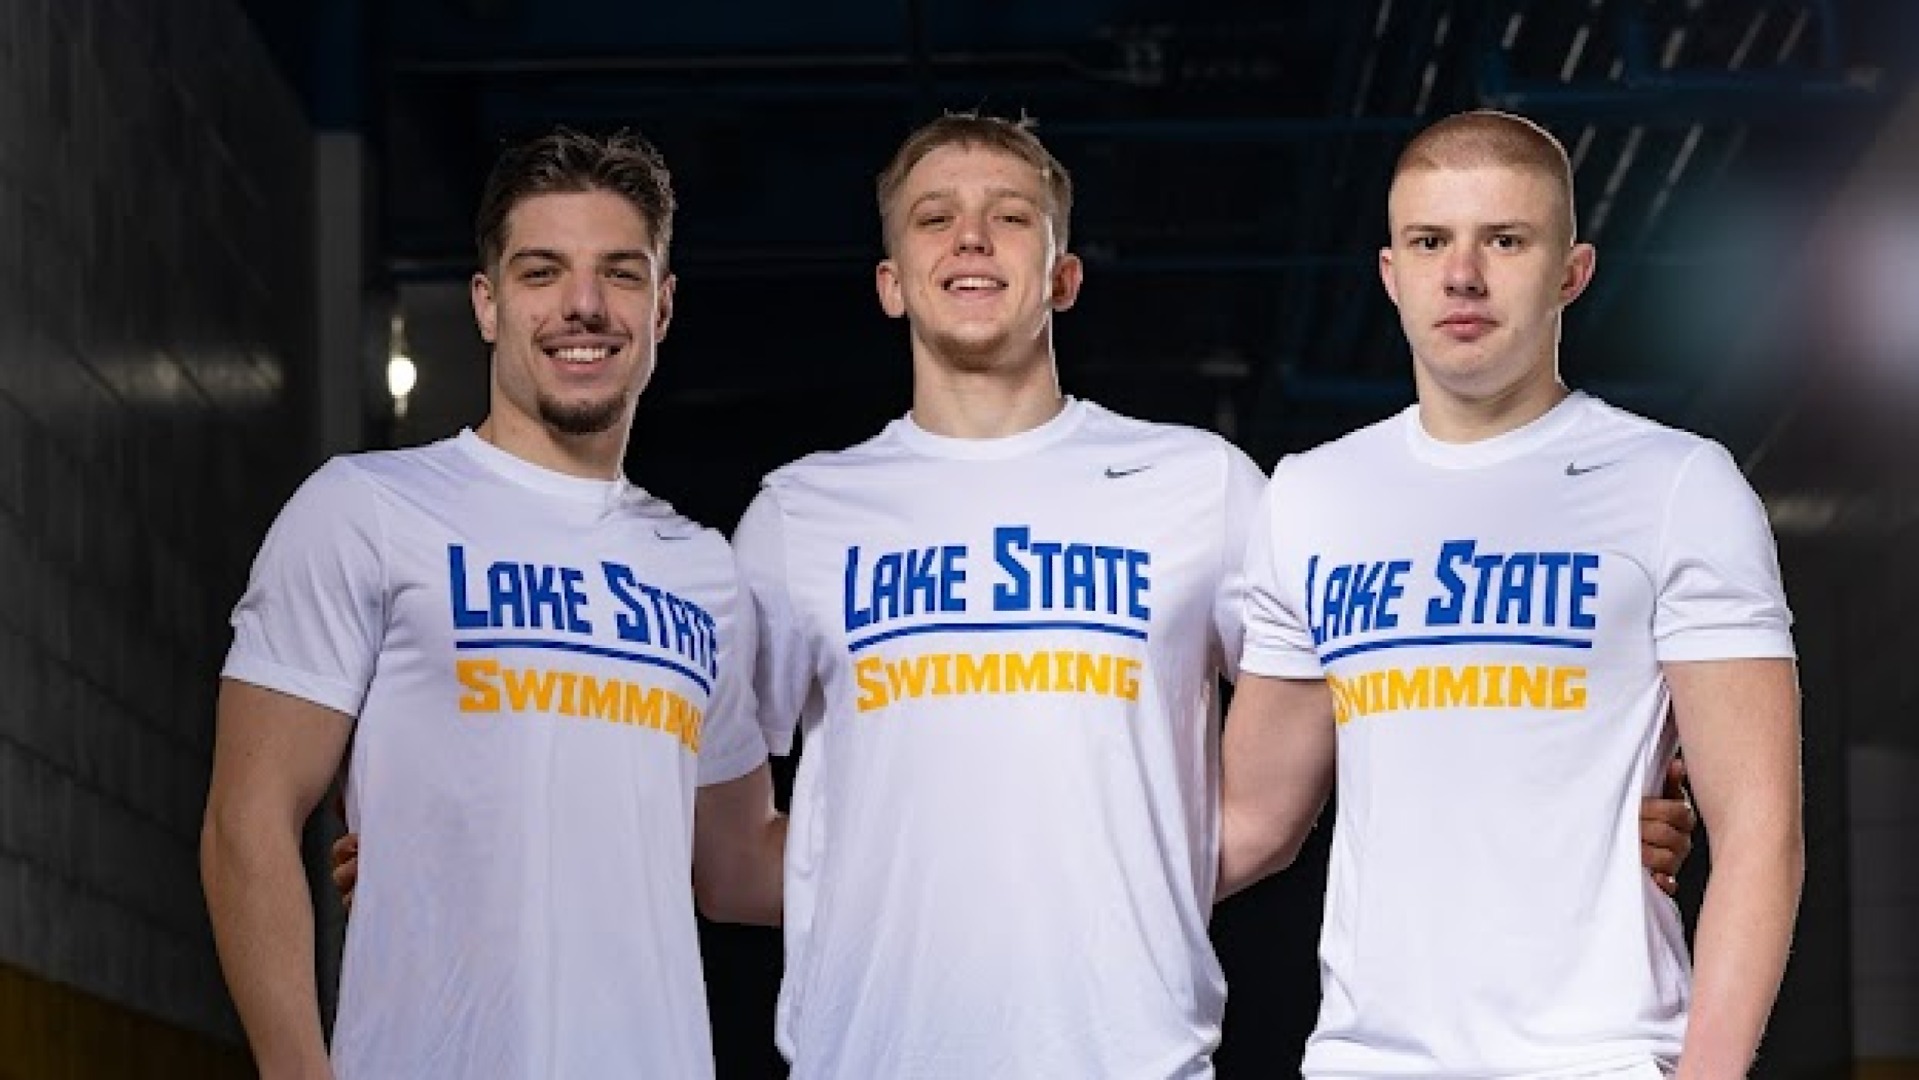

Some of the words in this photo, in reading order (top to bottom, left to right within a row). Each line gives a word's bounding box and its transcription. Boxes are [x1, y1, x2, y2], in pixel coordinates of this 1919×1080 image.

[449, 544, 594, 635] LAKE
[844, 544, 968, 634] LAKE
[992, 525, 1150, 622] STATE
[1305, 554, 1412, 647] LAKE
[1424, 538, 1600, 630] STATE
[855, 651, 1142, 713] SWIMMING
